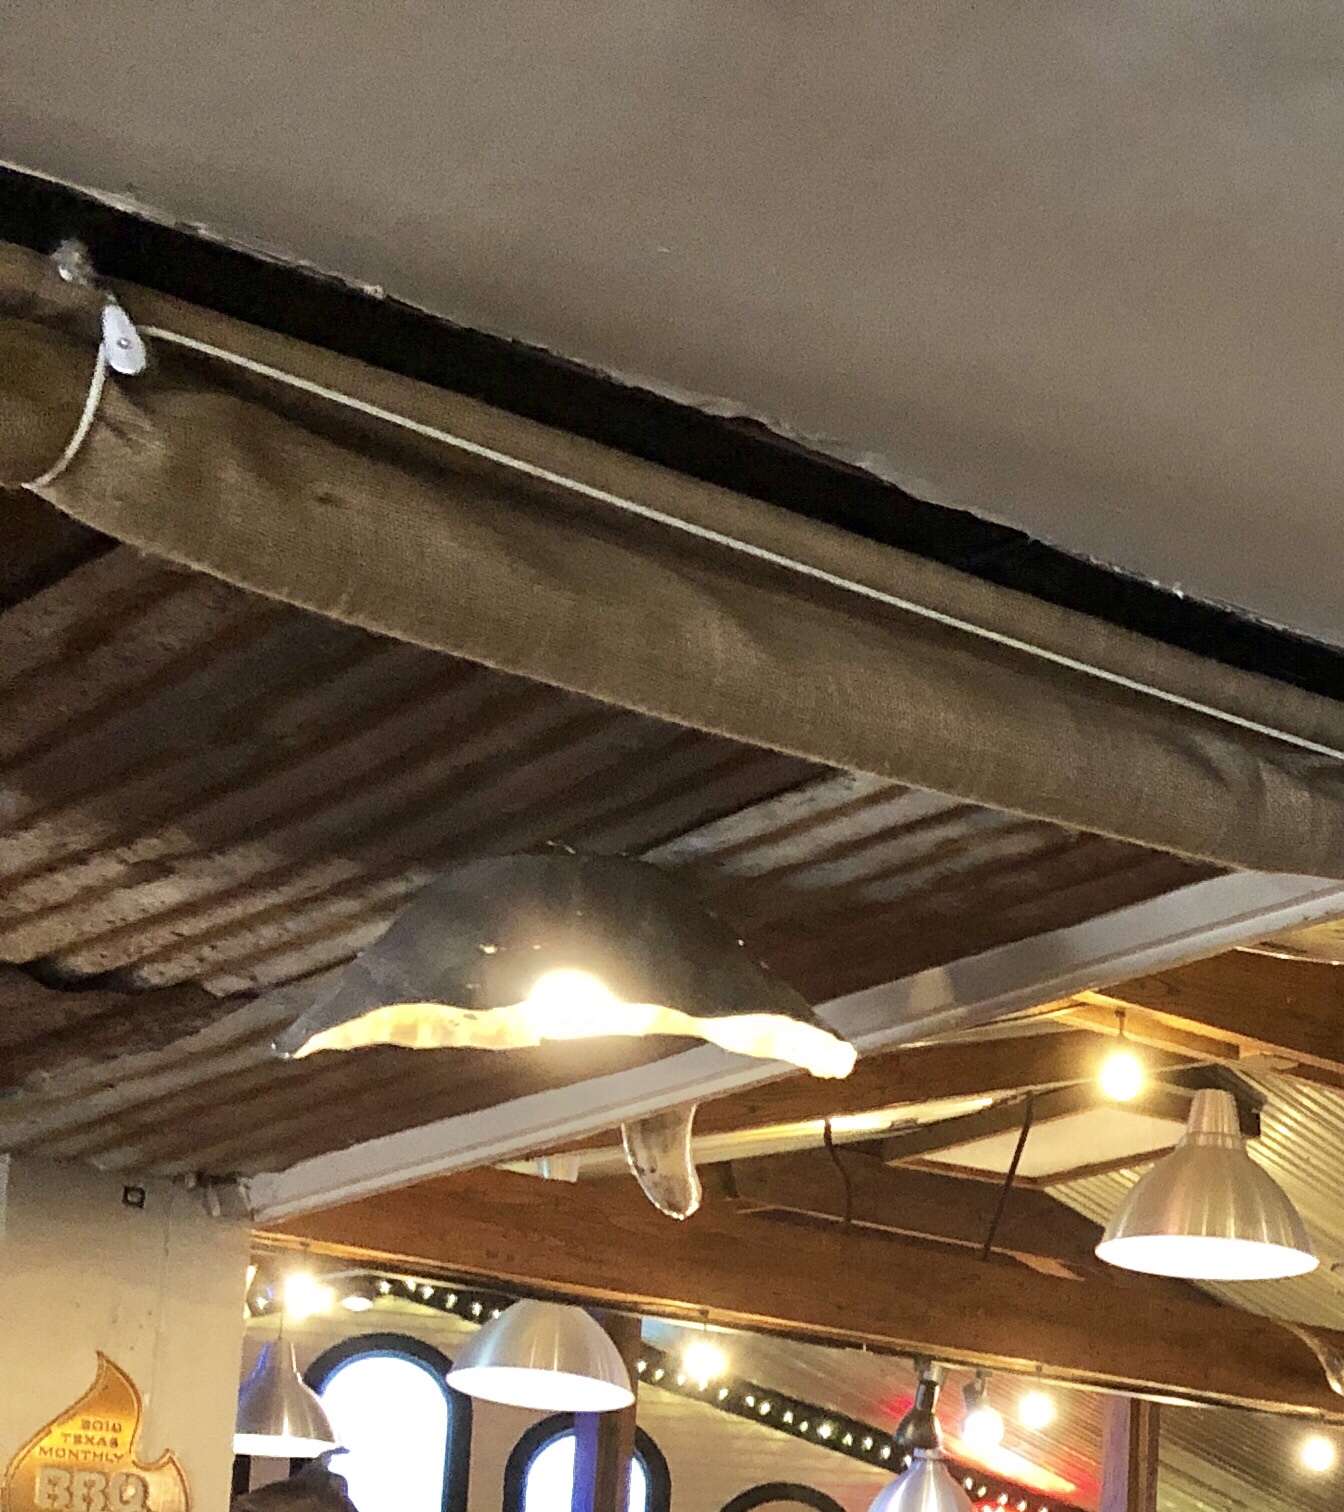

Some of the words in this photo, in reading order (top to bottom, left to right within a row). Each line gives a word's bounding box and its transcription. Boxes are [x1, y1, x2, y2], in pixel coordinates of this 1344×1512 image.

[61, 1432, 119, 1449] TEXAS
[38, 1445, 125, 1464] MONTHLY
[34, 1466, 151, 1512] BBQ
